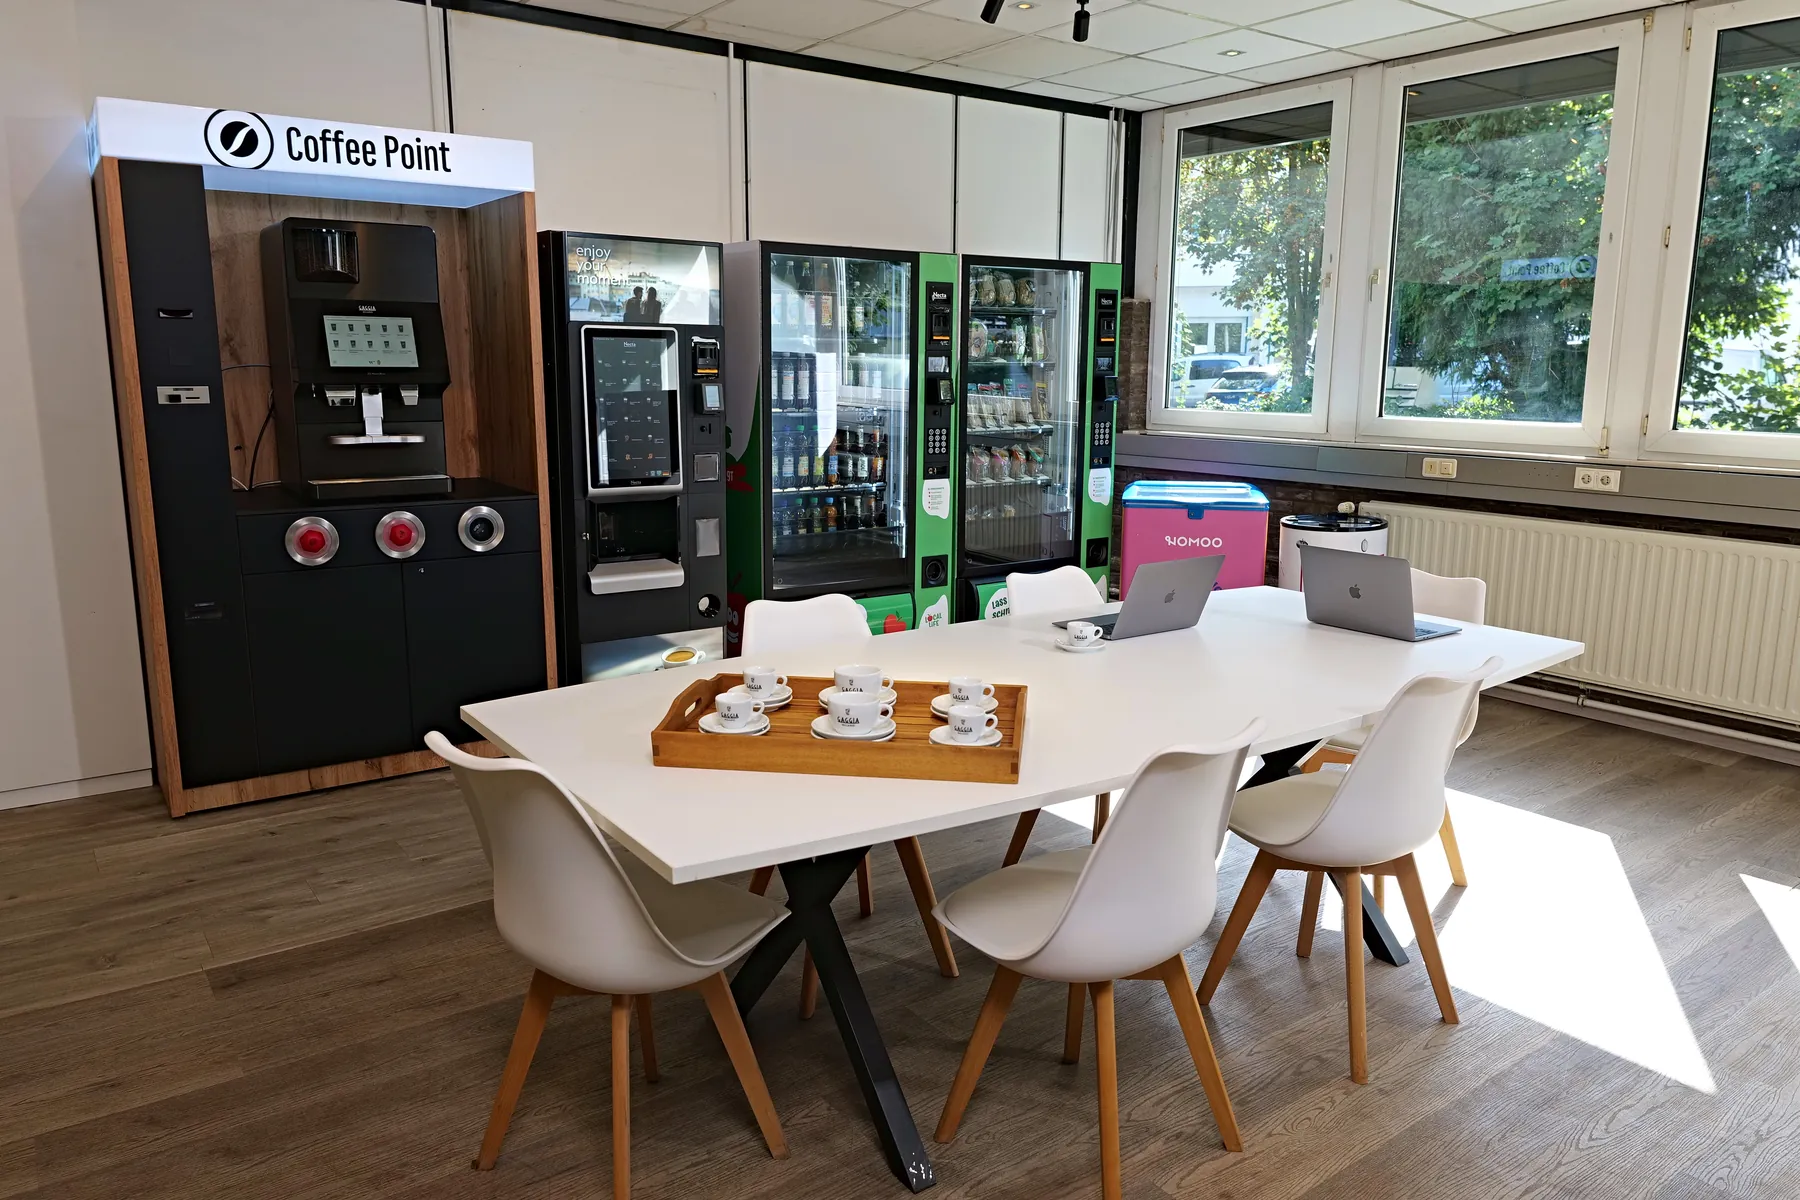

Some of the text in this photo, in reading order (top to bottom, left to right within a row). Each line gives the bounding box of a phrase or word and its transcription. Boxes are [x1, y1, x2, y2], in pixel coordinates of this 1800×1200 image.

[286, 126, 452, 173] Coffee Point
[576, 244, 611, 261] enjoy
[576, 261, 606, 274] your
[577, 275, 632, 286] moment
[1164, 535, 1223, 548] NOMOO
[720, 711, 740, 719] GAGGIA
[837, 716, 860, 725] GAGGIA
